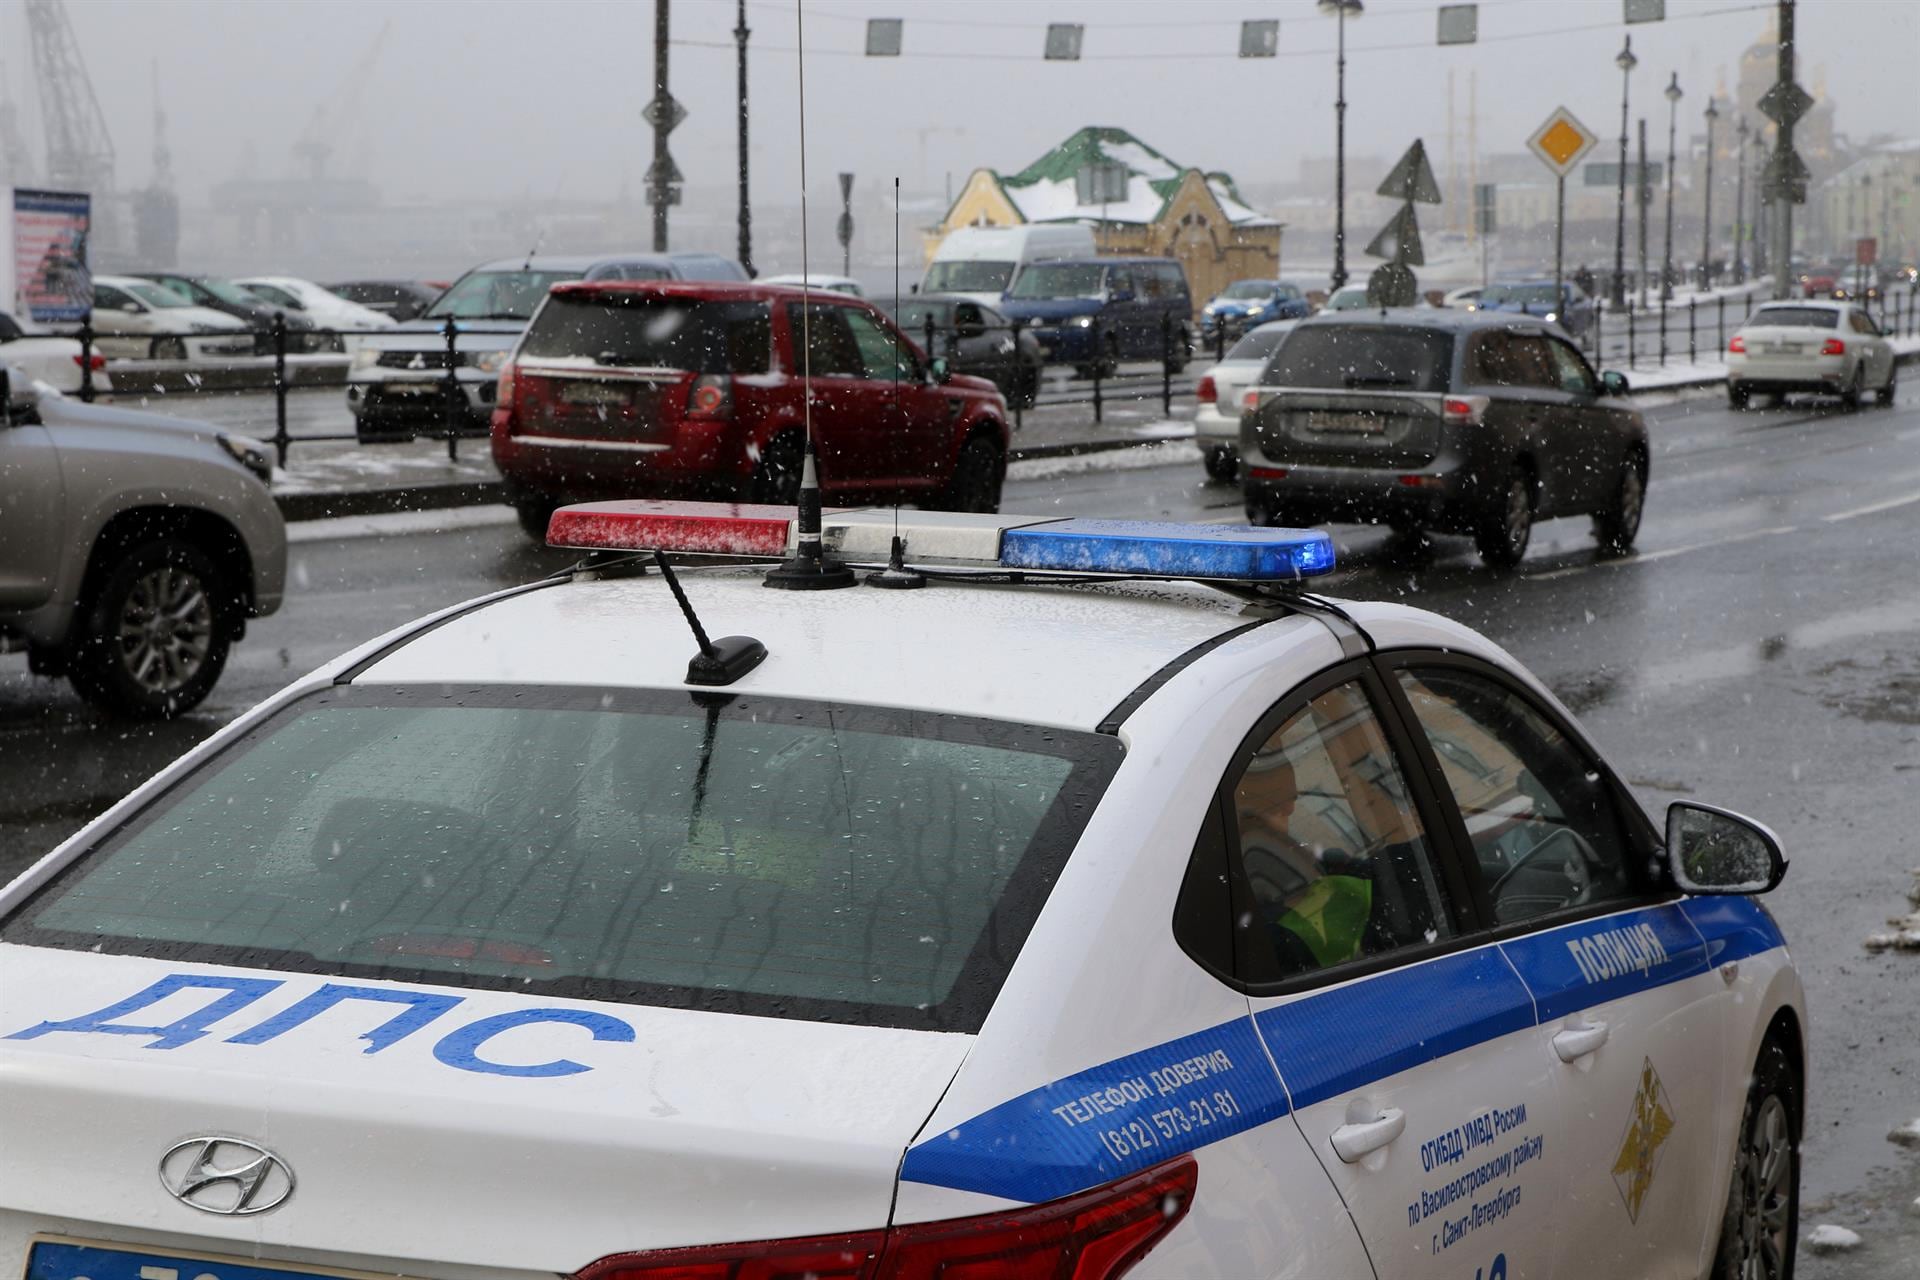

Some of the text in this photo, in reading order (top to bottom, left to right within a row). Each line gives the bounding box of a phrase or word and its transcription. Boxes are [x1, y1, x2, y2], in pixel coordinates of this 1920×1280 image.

[1566, 923, 1669, 985] ПОЛИЦИЯ
[2, 974, 636, 1078] ДПС
[1052, 1049, 1234, 1128] ТЕЛЕФОН ДОВЕРИЯ
[1099, 1088, 1242, 1161] (812) 573-21-81
[1420, 1103, 1527, 1173] ОГИБДД УМВД России
[1408, 1134, 1544, 1228] по Василеостровскому району
[1432, 1185, 1521, 1256] г. Санкт-Петербурга
